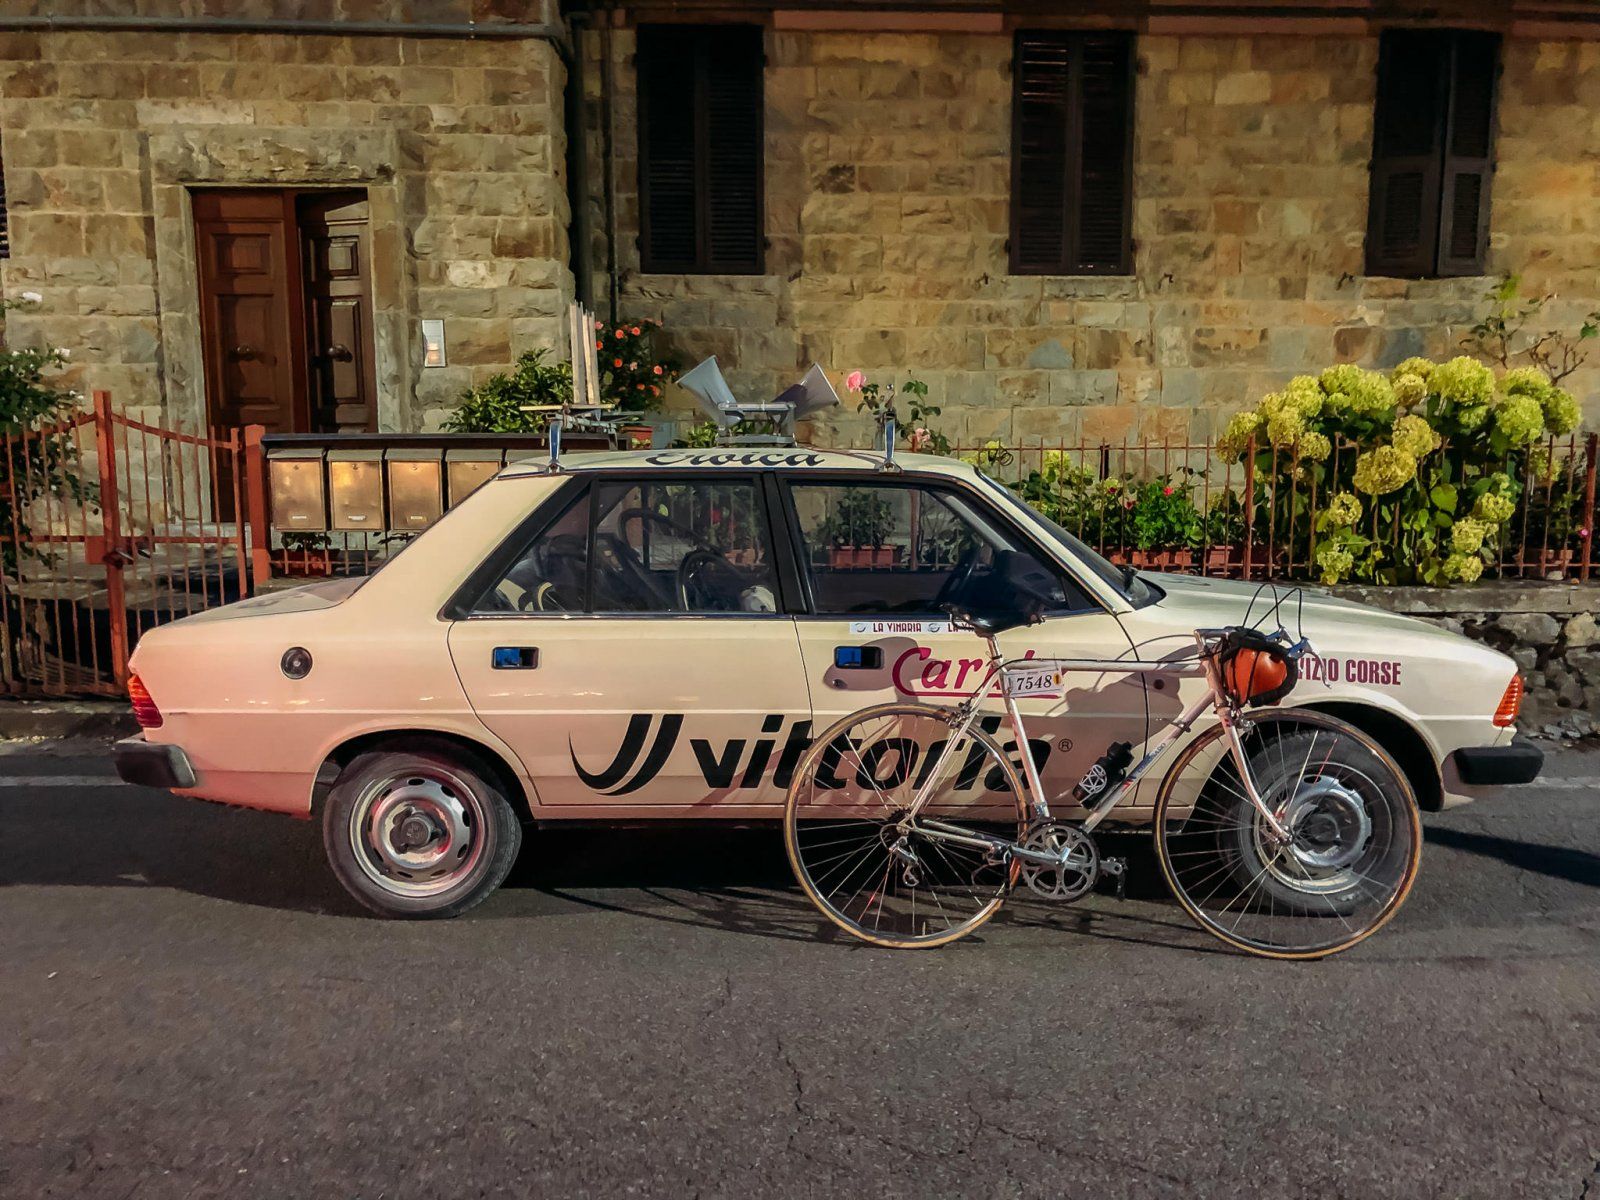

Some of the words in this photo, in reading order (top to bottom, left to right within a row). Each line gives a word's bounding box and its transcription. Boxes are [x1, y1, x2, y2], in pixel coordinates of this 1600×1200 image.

[645, 451, 826, 467] Eroica
[873, 622, 884, 633] LA
[1345, 659, 1402, 686] CORSE
[1016, 674, 1053, 691] 7548
[689, 713, 1052, 792] vittoria
